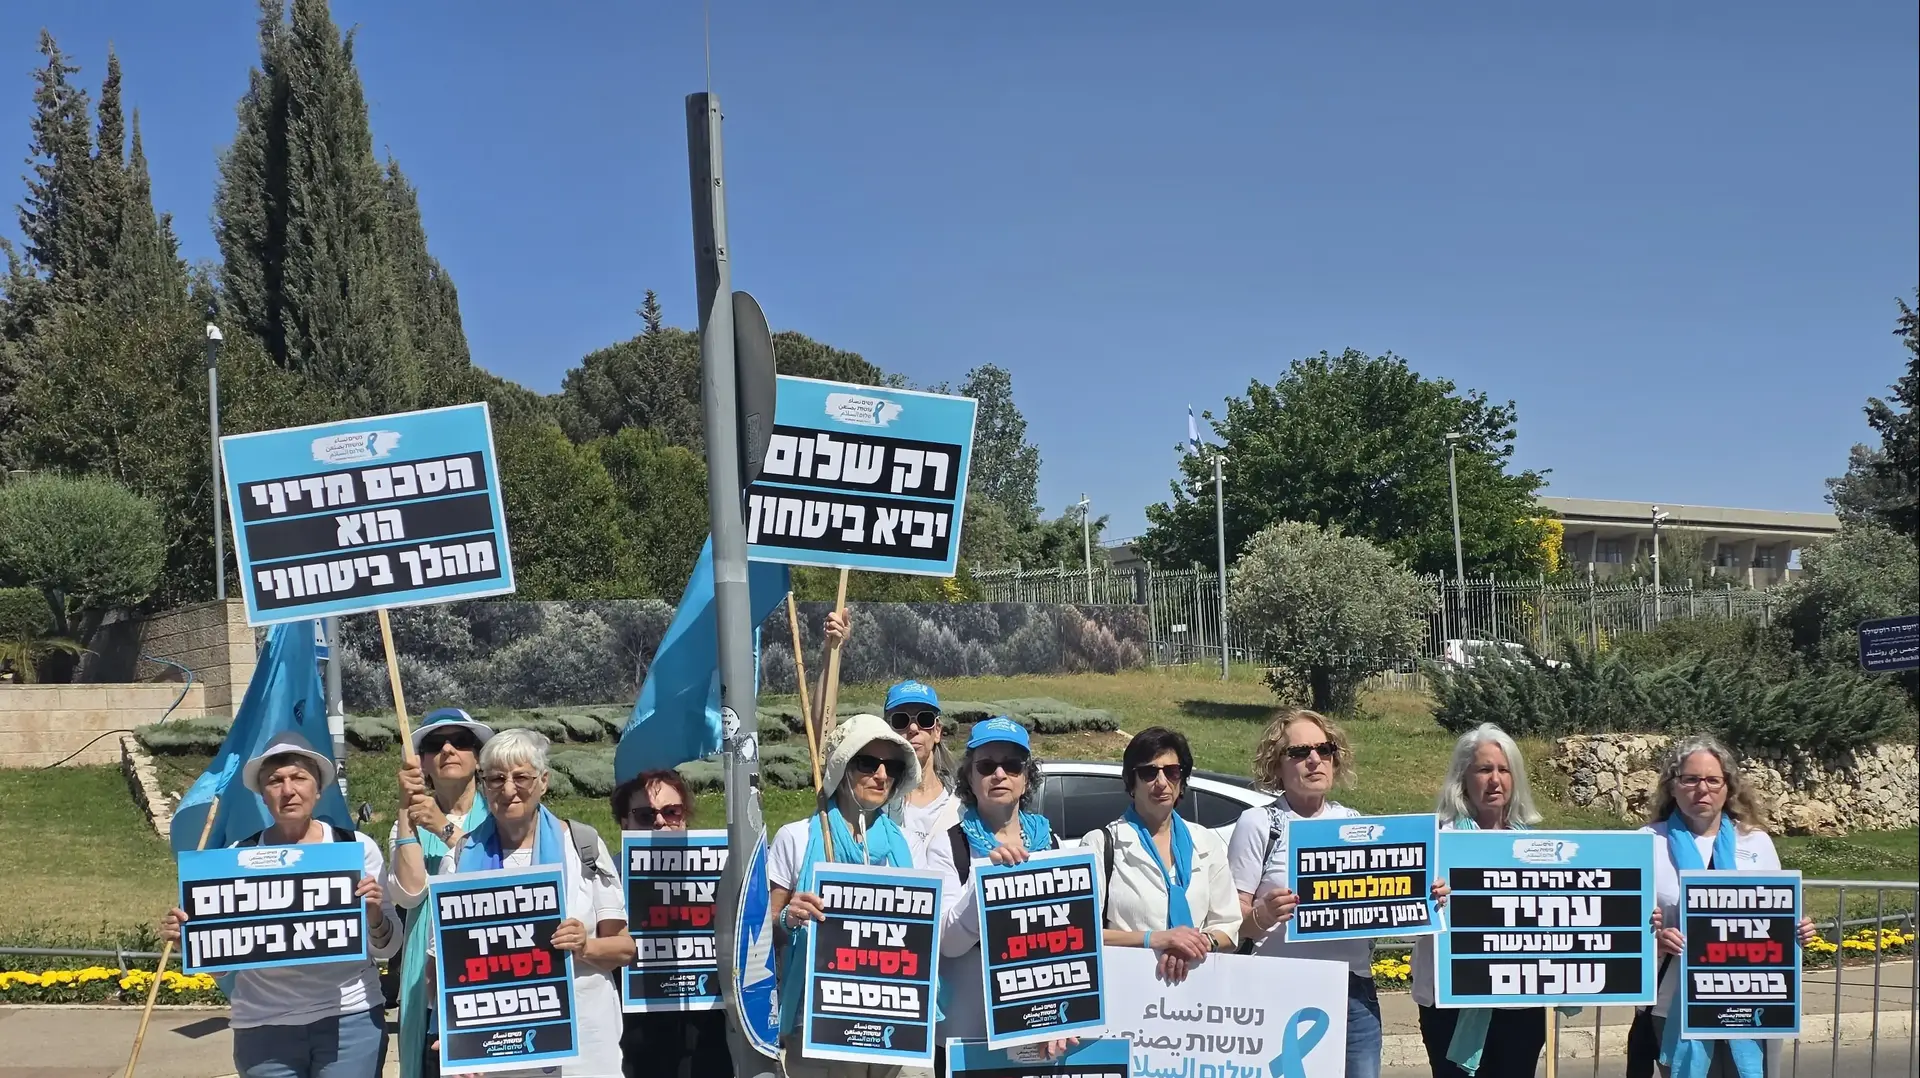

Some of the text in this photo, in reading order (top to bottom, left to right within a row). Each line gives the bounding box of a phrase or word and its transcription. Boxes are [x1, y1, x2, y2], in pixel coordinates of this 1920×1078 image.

[763, 433, 885, 484] שלום
[890, 448, 949, 493] רק
[251, 457, 475, 514] הסכם מדיני
[335, 509, 405, 547] הוא
[747, 495, 948, 549] יביא ביטחון
[258, 541, 495, 599] מהלך ביטחוני
[1301, 847, 1423, 872] ועדת חקירה
[654, 882, 715, 904] צריך
[985, 868, 1090, 902] מלחמות
[1313, 876, 1411, 900] ממלכתית
[1483, 869, 1611, 888] לא יהיה פה
[192, 877, 351, 915] רק שלום
[440, 885, 557, 920] מלחמות
[822, 885, 933, 915] מלחמות
[1492, 896, 1601, 927] עתיד
[1688, 886, 1793, 908] מלחמות
[641, 904, 717, 927] סיים.
[1011, 903, 1070, 934] צריך
[1300, 902, 1427, 929] למען ביטחון ילדינו
[1711, 919, 1770, 941] צריך
[189, 919, 358, 967] יביא ביטחון
[469, 924, 535, 955] צריך
[636, 937, 716, 959] הסכם
[843, 921, 907, 947] צריך
[1002, 926, 1083, 959] לסיים.
[1483, 934, 1611, 951] עד שנעשה
[458, 949, 552, 983] לסיים.
[828, 948, 918, 975] לסיים.
[1700, 941, 1782, 963] לסיים.
[997, 960, 1090, 993] בהסכם
[1489, 959, 1606, 994] שלום
[1694, 973, 1787, 992] בהסכם
[453, 986, 561, 1018] בהסכם
[821, 980, 919, 1011] בהסכם
[1143, 997, 1264, 1026] נשים نساء
[1186, 1033, 1263, 1055] עושות
[1134, 1055, 1262, 1078] שלום السلا
